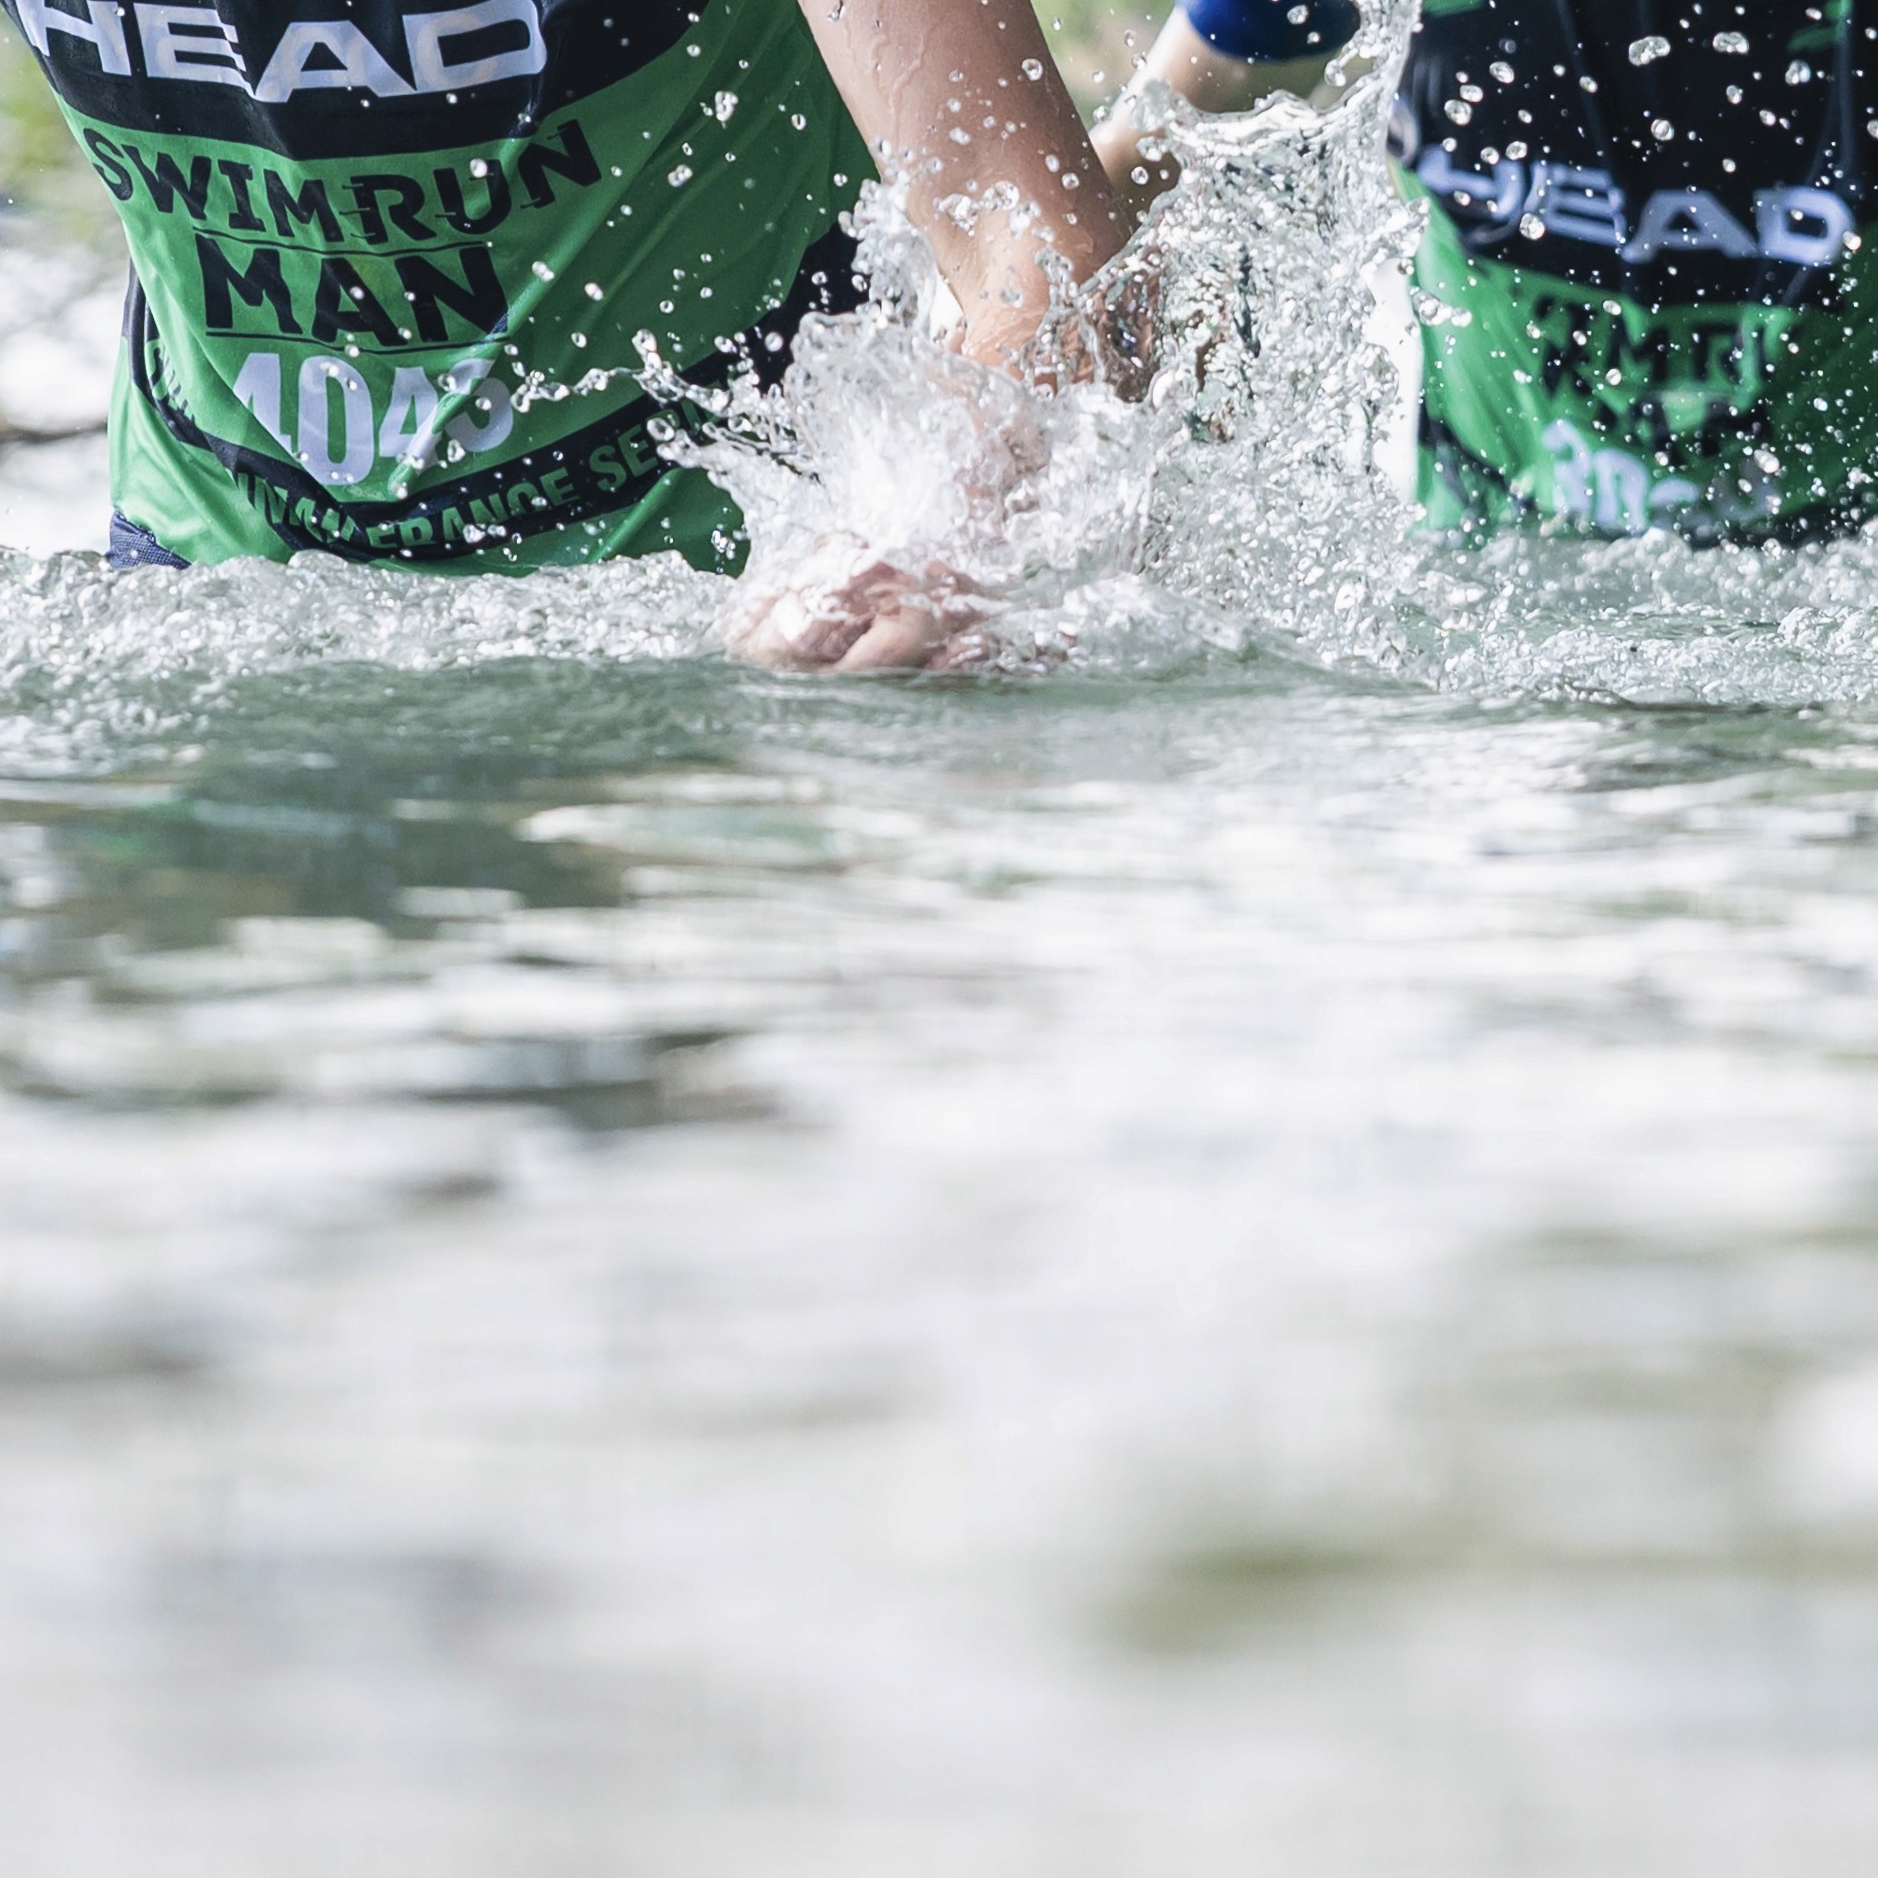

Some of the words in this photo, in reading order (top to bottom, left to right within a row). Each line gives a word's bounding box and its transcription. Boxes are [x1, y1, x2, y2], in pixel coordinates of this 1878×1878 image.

[84, 119, 602, 246] SWIMRUN
[1416, 144, 1854, 265] HEAD
[194, 233, 509, 347] MAN
